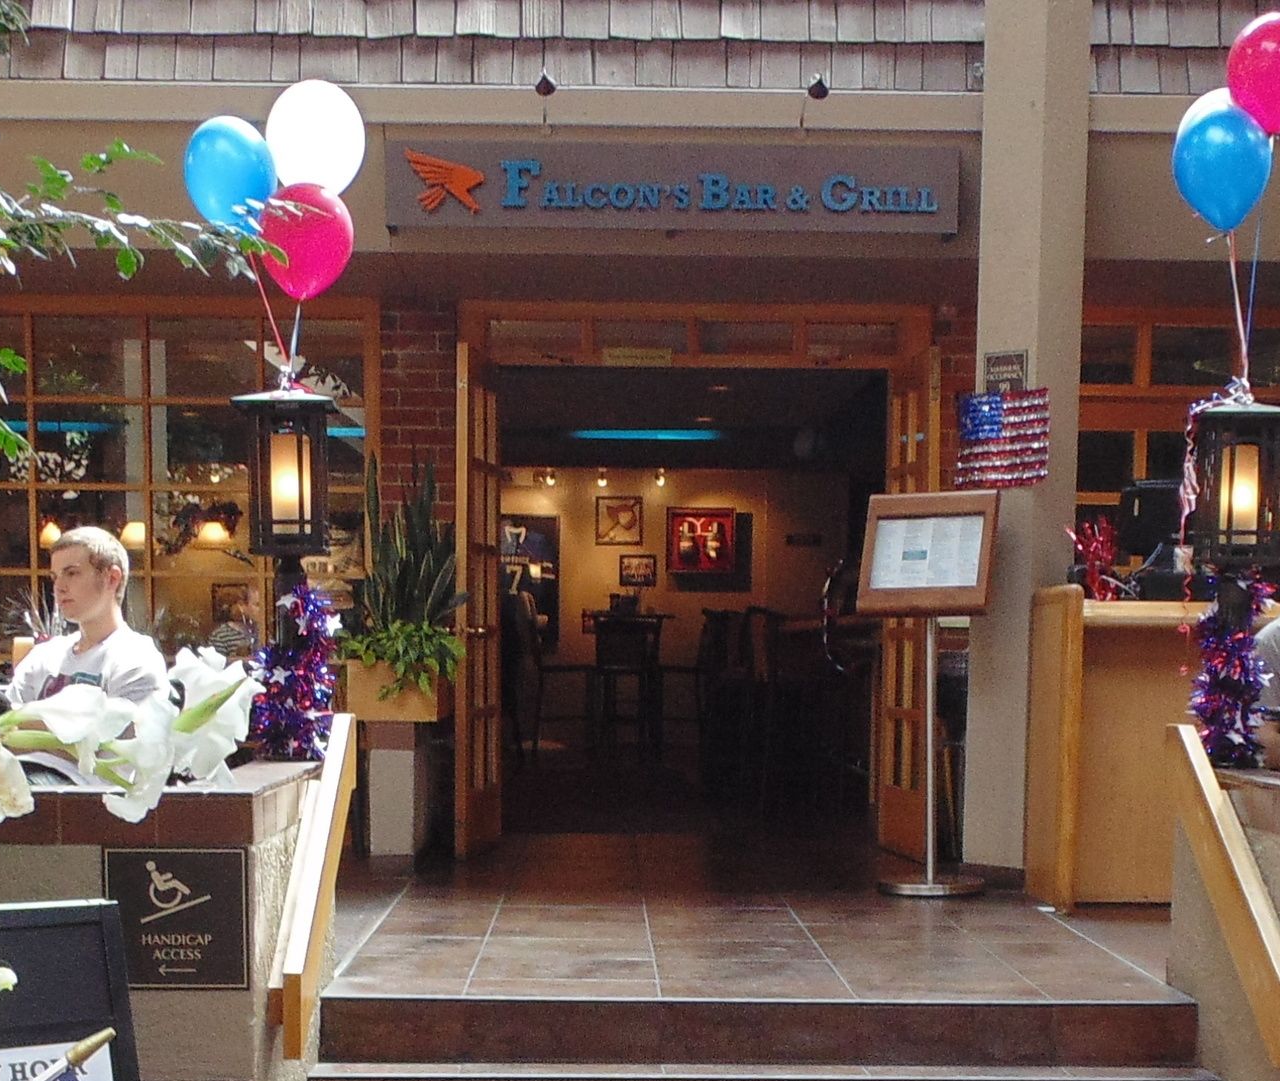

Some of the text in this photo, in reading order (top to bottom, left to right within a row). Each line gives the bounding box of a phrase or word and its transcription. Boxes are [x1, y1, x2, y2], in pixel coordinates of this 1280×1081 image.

[500, 160, 939, 214] FALCON'S BAR & GRILL
[141, 933, 212, 946] HANDICAP
[152, 948, 202, 960] ACCESS
